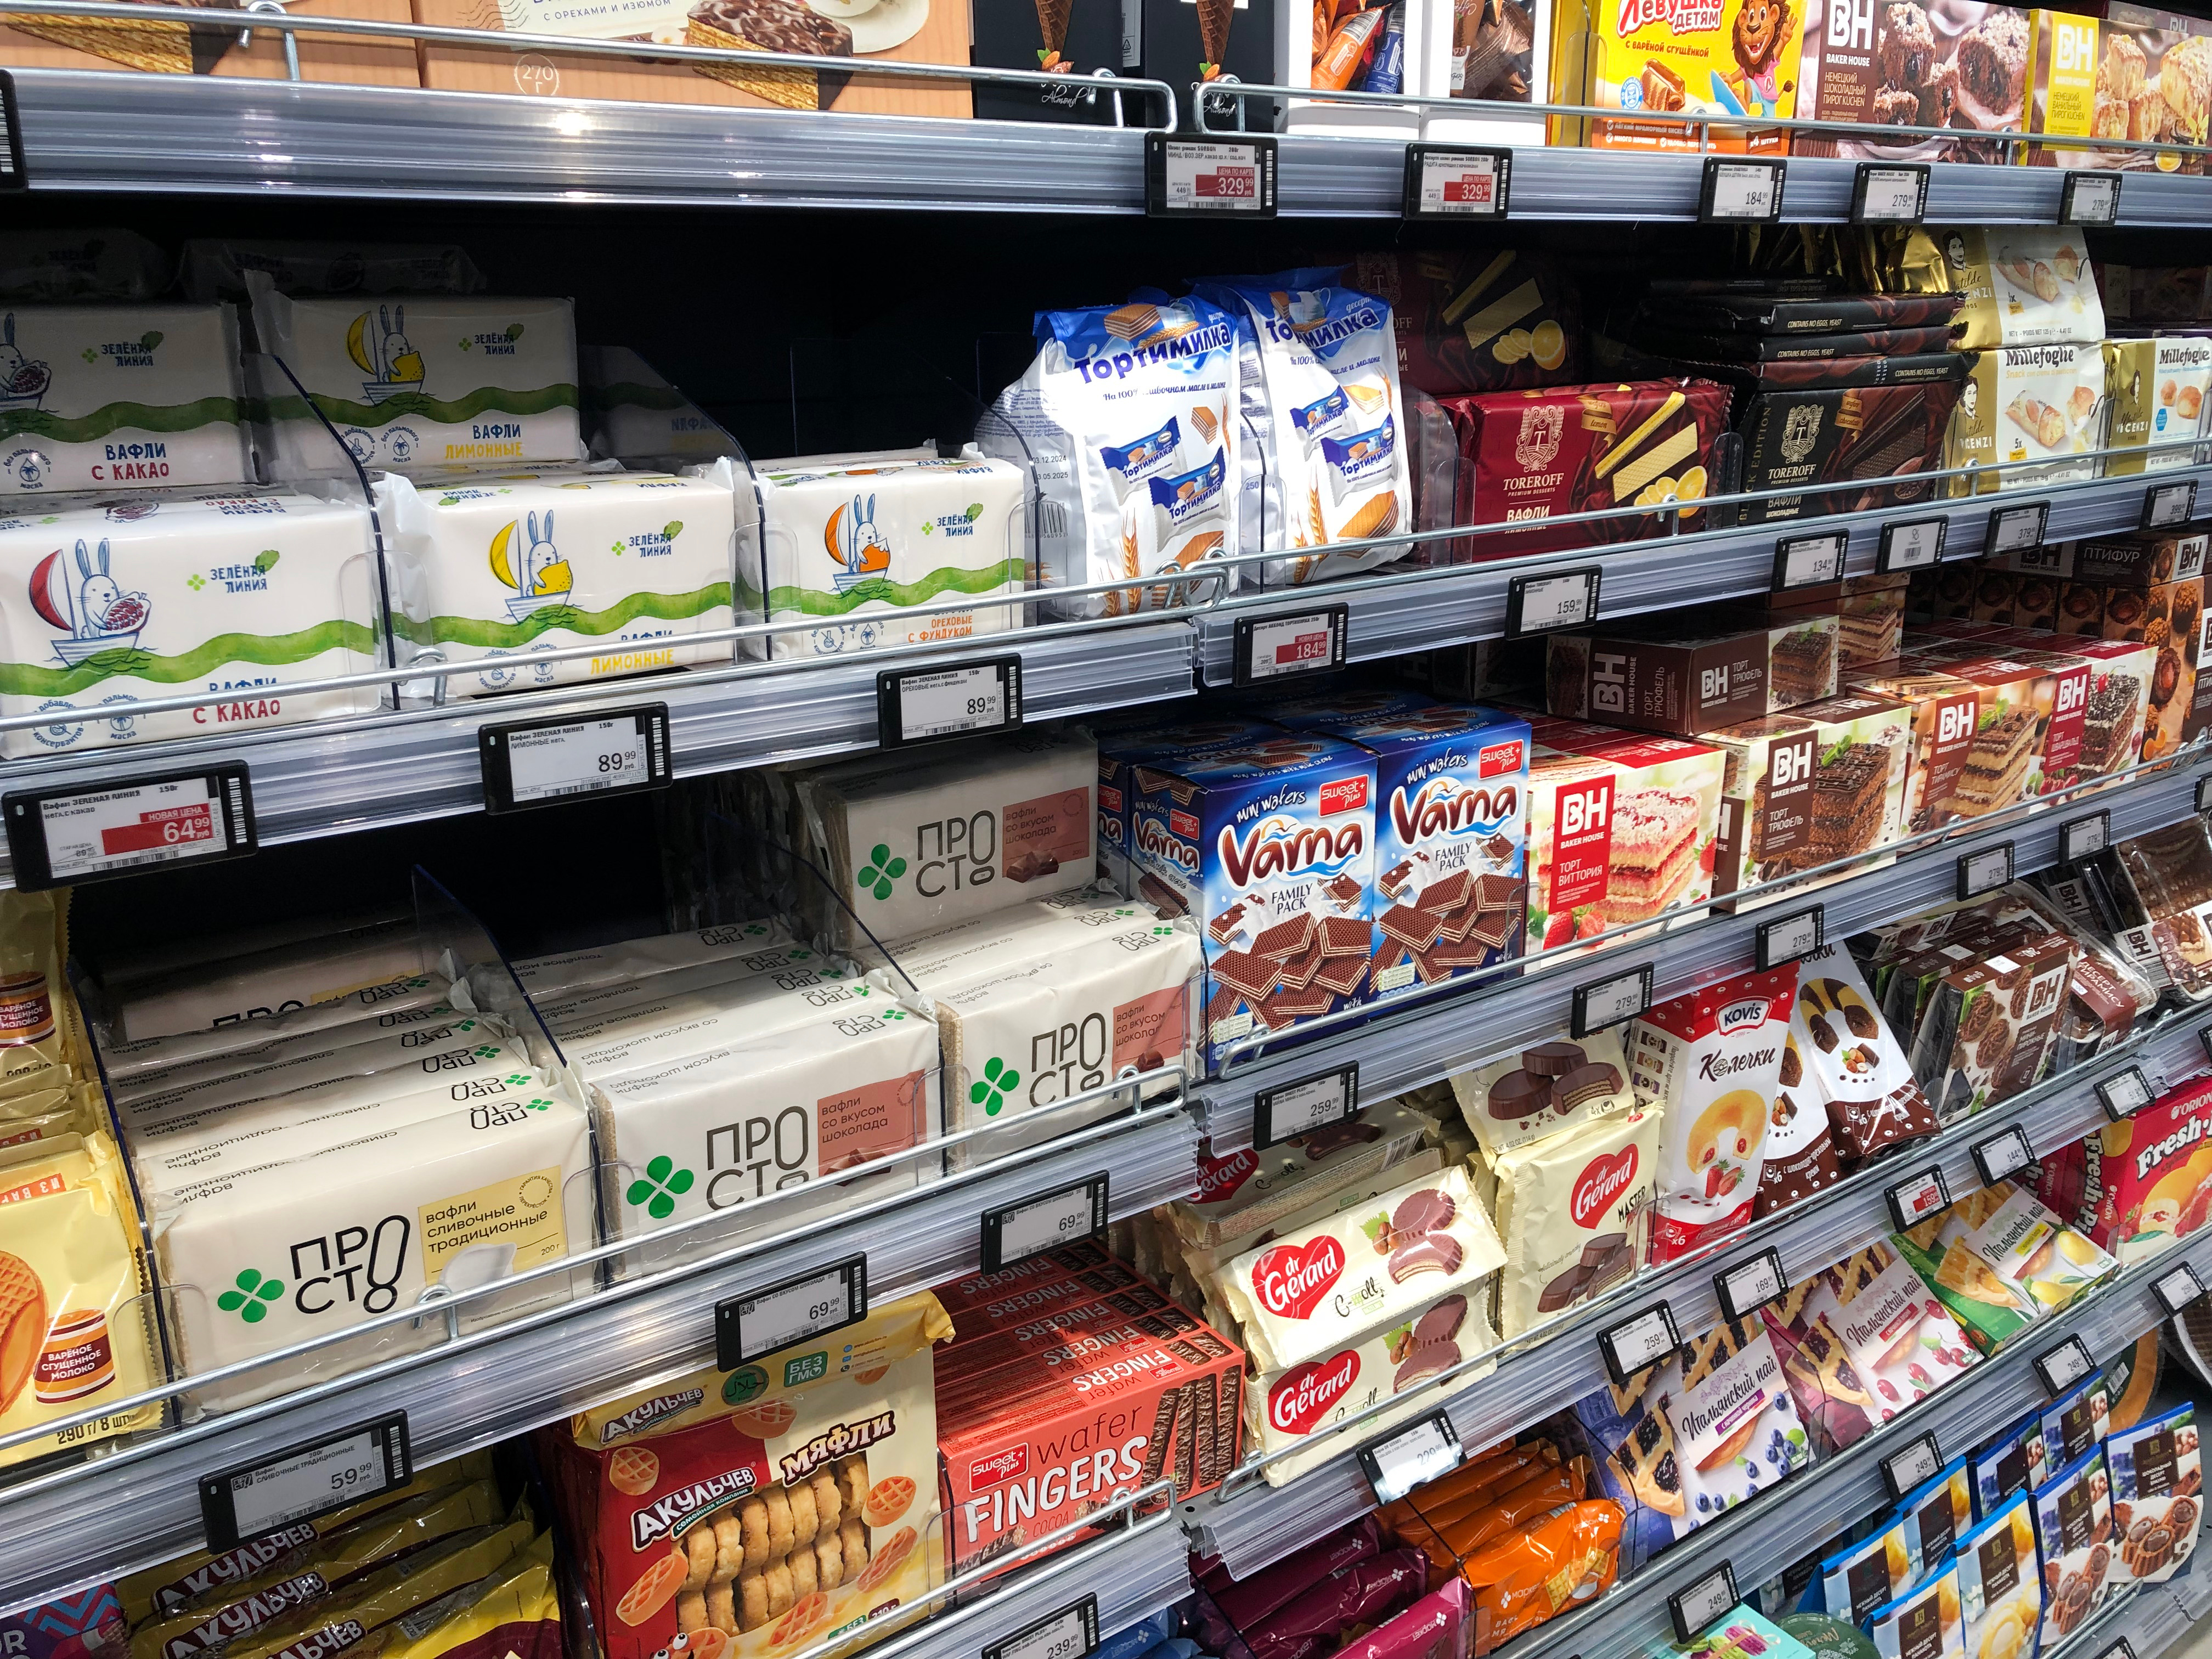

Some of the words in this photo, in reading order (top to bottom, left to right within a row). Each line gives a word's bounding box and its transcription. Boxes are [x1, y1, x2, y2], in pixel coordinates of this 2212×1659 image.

[555, 6, 607, 20] ОРЕХАМИ
[1675, 11, 1718, 29] ДЕТЯМ
[1828, 0, 1874, 50] BH
[1633, 41, 1664, 52] ВАРЁНОЙ
[1667, 45, 1709, 58] СГУЩЁНКОЙ
[2056, 24, 2094, 71] BH
[1826, 54, 1847, 65] BAKER
[1848, 55, 1870, 67] HOUSE
[521, 65, 553, 82] 270
[1825, 71, 1858, 83] НЕМЕЦКИЙ
[1824, 83, 1866, 96] ШОКОЛАДНЫЙ
[2053, 92, 2080, 101] НЕМЕЦКИЙ
[1823, 94, 1842, 104] ПИРОГ
[1843, 96, 1865, 108] KUCHEN
[2052, 100, 2082, 111] ВАНИЛЬНЫЙ
[1218, 177, 1244, 195] 329
[1462, 184, 1482, 199] 329
[1746, 191, 1762, 206] 184
[1892, 194, 1908, 207] 279
[474, 333, 515, 345] ЗЕЛЁНАЯ
[101, 342, 154, 356] ЗЕЛЁНАЯ
[485, 345, 515, 356] ЛИНИЯ
[1074, 321, 1232, 384] Тортимилка
[2006, 346, 2074, 366] Millefoglie
[2159, 348, 2210, 365] Millefoglie
[116, 355, 154, 367] ЛИНИЯ
[1894, 368, 1915, 377] CONTAINS
[472, 424, 521, 439] ВАФЛИ
[105, 442, 166, 461] ВАФЛИ
[445, 442, 523, 460] ЛИМОННЫЕ
[113, 461, 170, 480] КАКАО
[1768, 464, 1817, 481] TOREROFF
[1503, 472, 1565, 491] TOREROFF
[1168, 481, 1221, 521] Тортимилка
[1508, 489, 1532, 498] PREMIUM
[1532, 487, 1556, 495] DESSERTS
[936, 514, 974, 527] ЗЕЛЁНАЯ
[1506, 505, 1550, 522] ВАФЛИ
[1765, 507, 1799, 518] ШОКОЛАДНЫЕ
[628, 532, 672, 547] ЗЕЛЁНАЯ
[945, 525, 974, 538] ЛИНИЯ
[639, 545, 672, 558] ЛИНИЯ
[2085, 546, 2141, 565] ПТИФУР
[210, 563, 266, 581] ЗЕЛЁНАЯ
[224, 578, 267, 594] ЛИНИЯ
[1557, 600, 1575, 615] 159
[931, 615, 973, 629] ОРЕХОВЫЕ
[919, 627, 972, 642] ФУНДУКОМ
[1297, 642, 1319, 659] 184
[590, 648, 674, 675] ЛИМОННЫЕ
[1733, 659, 1749, 672] ТОРТ
[1701, 664, 1729, 698] BH
[1733, 668, 1763, 684] ТРЮФЕЛЬ
[902, 684, 929, 692] ОРЕХОВЫЕ
[2057, 674, 2088, 712] BH
[216, 699, 281, 723] КАКАО
[967, 697, 985, 714] 89
[987, 696, 996, 704] 99
[1938, 702, 1975, 743] BH
[511, 738, 550, 750] ЛИМОННЫЕ
[599, 753, 623, 772] 89
[624, 751, 636, 760] 99
[1428, 751, 1468, 776] wafers
[1771, 741, 1813, 788] BH
[1261, 783, 1307, 814] wafers
[1771, 788, 1790, 799] BAKER
[1790, 783, 1809, 795] HOUSE
[148, 810, 178, 821] НОВАЯ
[179, 806, 203, 817] ЦЕНА
[1005, 805, 1037, 822] вафли
[1395, 781, 1517, 845] Varna
[1561, 786, 1609, 836] BH
[1769, 807, 1789, 821] ТОРТ
[163, 821, 196, 843] 64
[194, 817, 210, 828] 99
[1005, 821, 1018, 833] со
[1020, 812, 1055, 831] вкусом
[1768, 814, 1804, 834] ТРЮФЕЛЬ
[1005, 825, 1057, 845] шоколада
[1133, 816, 1199, 871] Varna
[1560, 836, 1581, 849] BAKER
[1582, 831, 1605, 845] HOUSE
[1222, 823, 1363, 885] Varna
[1434, 841, 1472, 862] FAMILY
[1438, 853, 1467, 872] PACK
[1559, 858, 1582, 873] ТОРТ
[1558, 864, 1603, 887] ВИТТОРИЯ
[1271, 883, 1314, 905] FAMILY
[1276, 896, 1307, 915] PACK
[1792, 935, 1807, 948] 279
[1615, 994, 1632, 1011] 279
[2030, 976, 2061, 1015] BH
[1116, 1004, 1145, 1022] вафли
[1130, 1011, 1166, 1030] вкусом
[1700, 1046, 1776, 1082] Колечки
[821, 1097, 861, 1116] вафли
[1310, 1099, 1331, 1117] 259
[821, 1117, 838, 1130] со
[840, 1103, 885, 1126] вкусом
[822, 1116, 889, 1144] шоколада
[1576, 1153, 1633, 1220] Gerard
[426, 1201, 477, 1224] вафли
[427, 1204, 515, 1238] сливочные
[1059, 1215, 1075, 1231] 69
[1076, 1211, 1085, 1220] 99
[428, 1210, 548, 1254] традиционные
[541, 1245, 555, 1256] 200
[1264, 1248, 1339, 1312] Gerard
[1755, 1277, 1770, 1294] 169
[809, 1302, 828, 1320] 69
[830, 1297, 839, 1306] 99
[1847, 1290, 1904, 1346] Итальянский
[1043, 1325, 1142, 1366] FINGERS
[1644, 1334, 1660, 1350] 259
[48, 1344, 93, 1362] ВАРЁНОЕ
[50, 1362, 96, 1381] МОЛОКО
[789, 1357, 823, 1374] БЕЗ
[1071, 1349, 1173, 1392] FINGERS
[1088, 1376, 1143, 1401] wafer
[1274, 1357, 1352, 1427] Gerard
[1682, 1373, 1756, 1441] Итальянский
[1756, 1355, 1776, 1383] пай
[603, 1388, 703, 1443] АКУЛЬЧЕВ
[56, 1423, 84, 1445] 290
[1036, 1406, 1143, 1465] wafer
[784, 1413, 893, 1482] МЯФЛИ
[256, 1464, 300, 1483] СЛИВОЧНЫЕ
[301, 1444, 356, 1468] ТРАДИЦИОННЫЕ
[1915, 1459, 1928, 1474] 249
[331, 1468, 358, 1490] 59
[359, 1462, 372, 1473] 99
[964, 1436, 1149, 1543] FINGERS
[635, 1468, 755, 1551] АКУЛЬЧЕВ
[675, 1506, 714, 1531] семейная
[714, 1487, 749, 1509] компания
[1032, 1511, 1070, 1538] COCOA
[1707, 1594, 1723, 1610] 249
